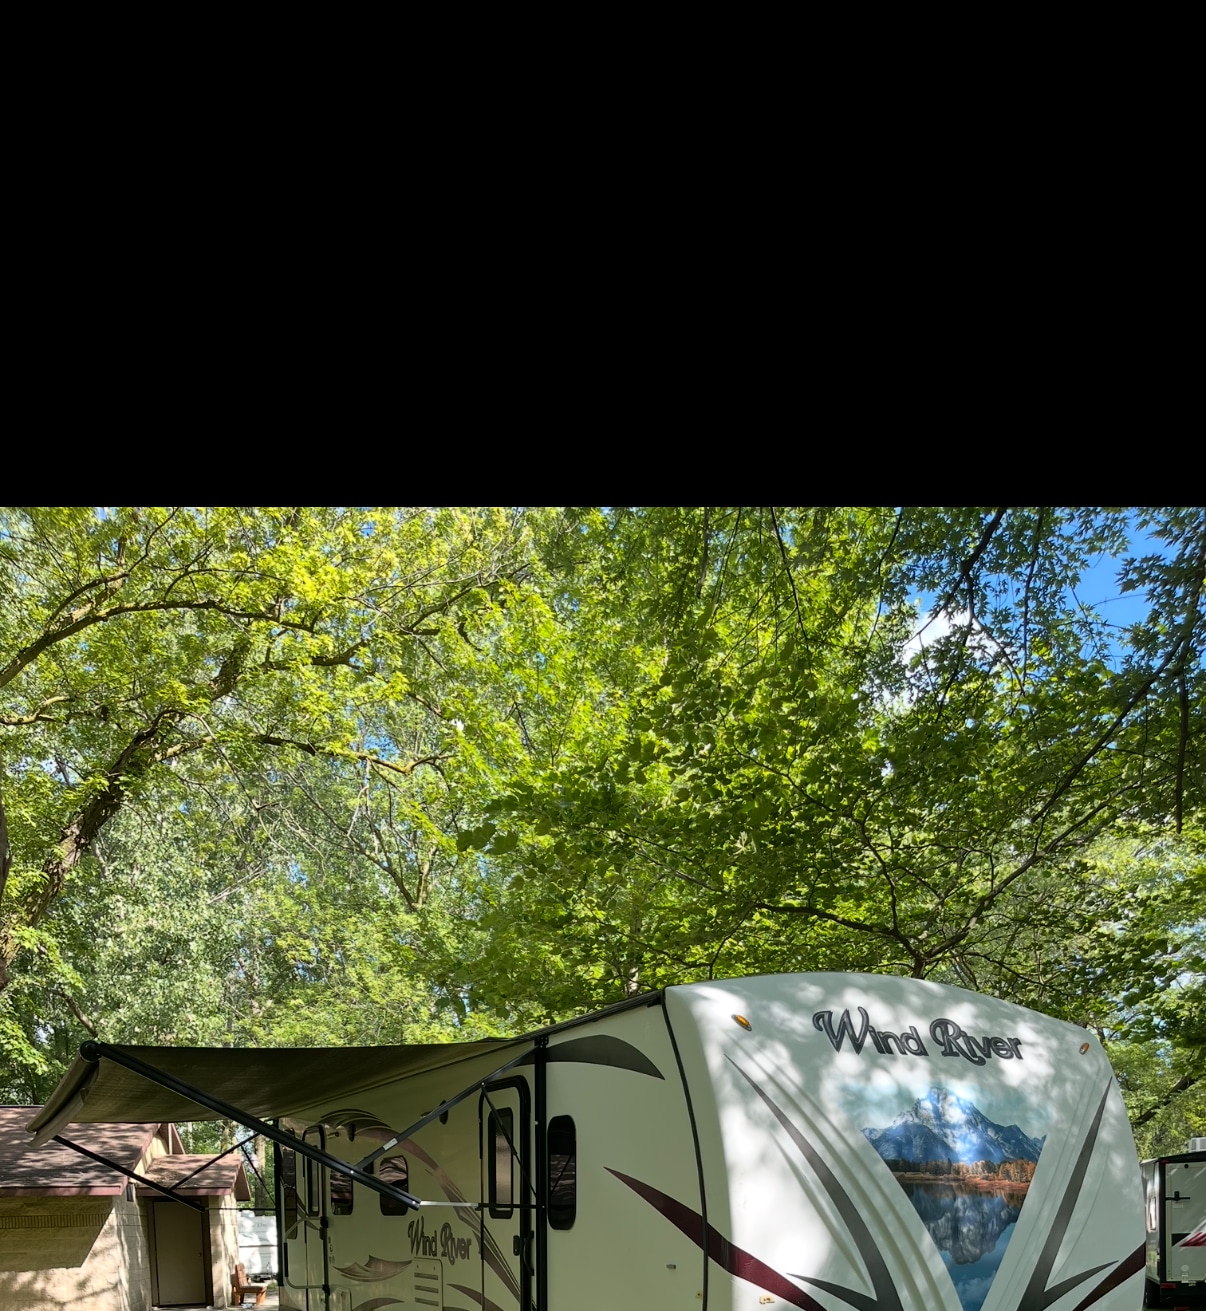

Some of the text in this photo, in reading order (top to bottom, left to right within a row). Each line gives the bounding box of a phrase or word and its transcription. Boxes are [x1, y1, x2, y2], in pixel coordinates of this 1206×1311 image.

[812, 1006, 1024, 1066] Wind River
[408, 1215, 472, 1266] Wind River
